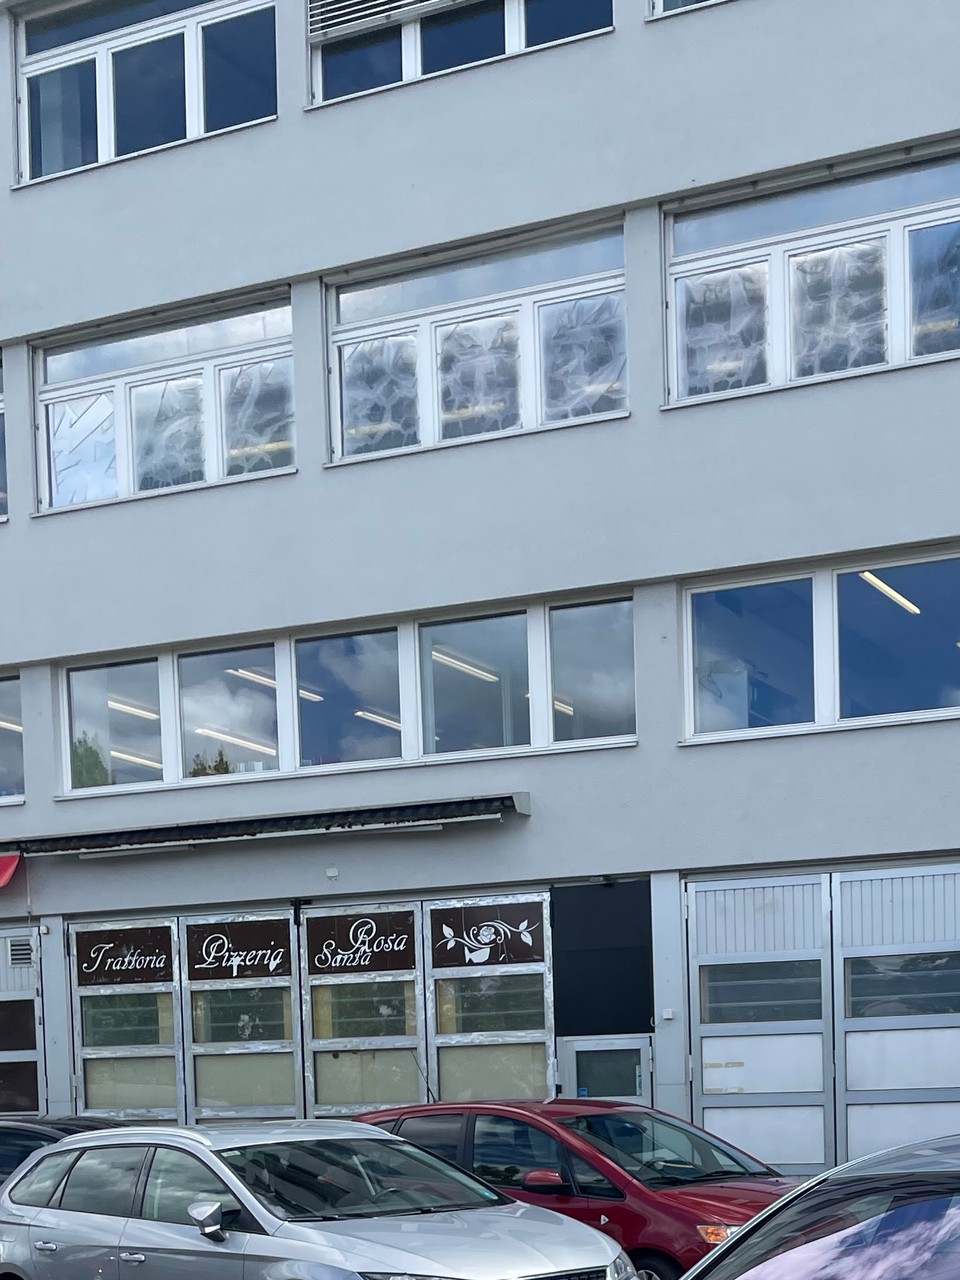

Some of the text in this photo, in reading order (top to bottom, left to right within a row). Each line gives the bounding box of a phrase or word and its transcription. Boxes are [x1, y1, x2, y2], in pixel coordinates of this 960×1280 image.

[82, 942, 167, 974] Trattoria
[194, 933, 285, 971] Pizzeria
[315, 917, 408, 968] Santa Rosa
